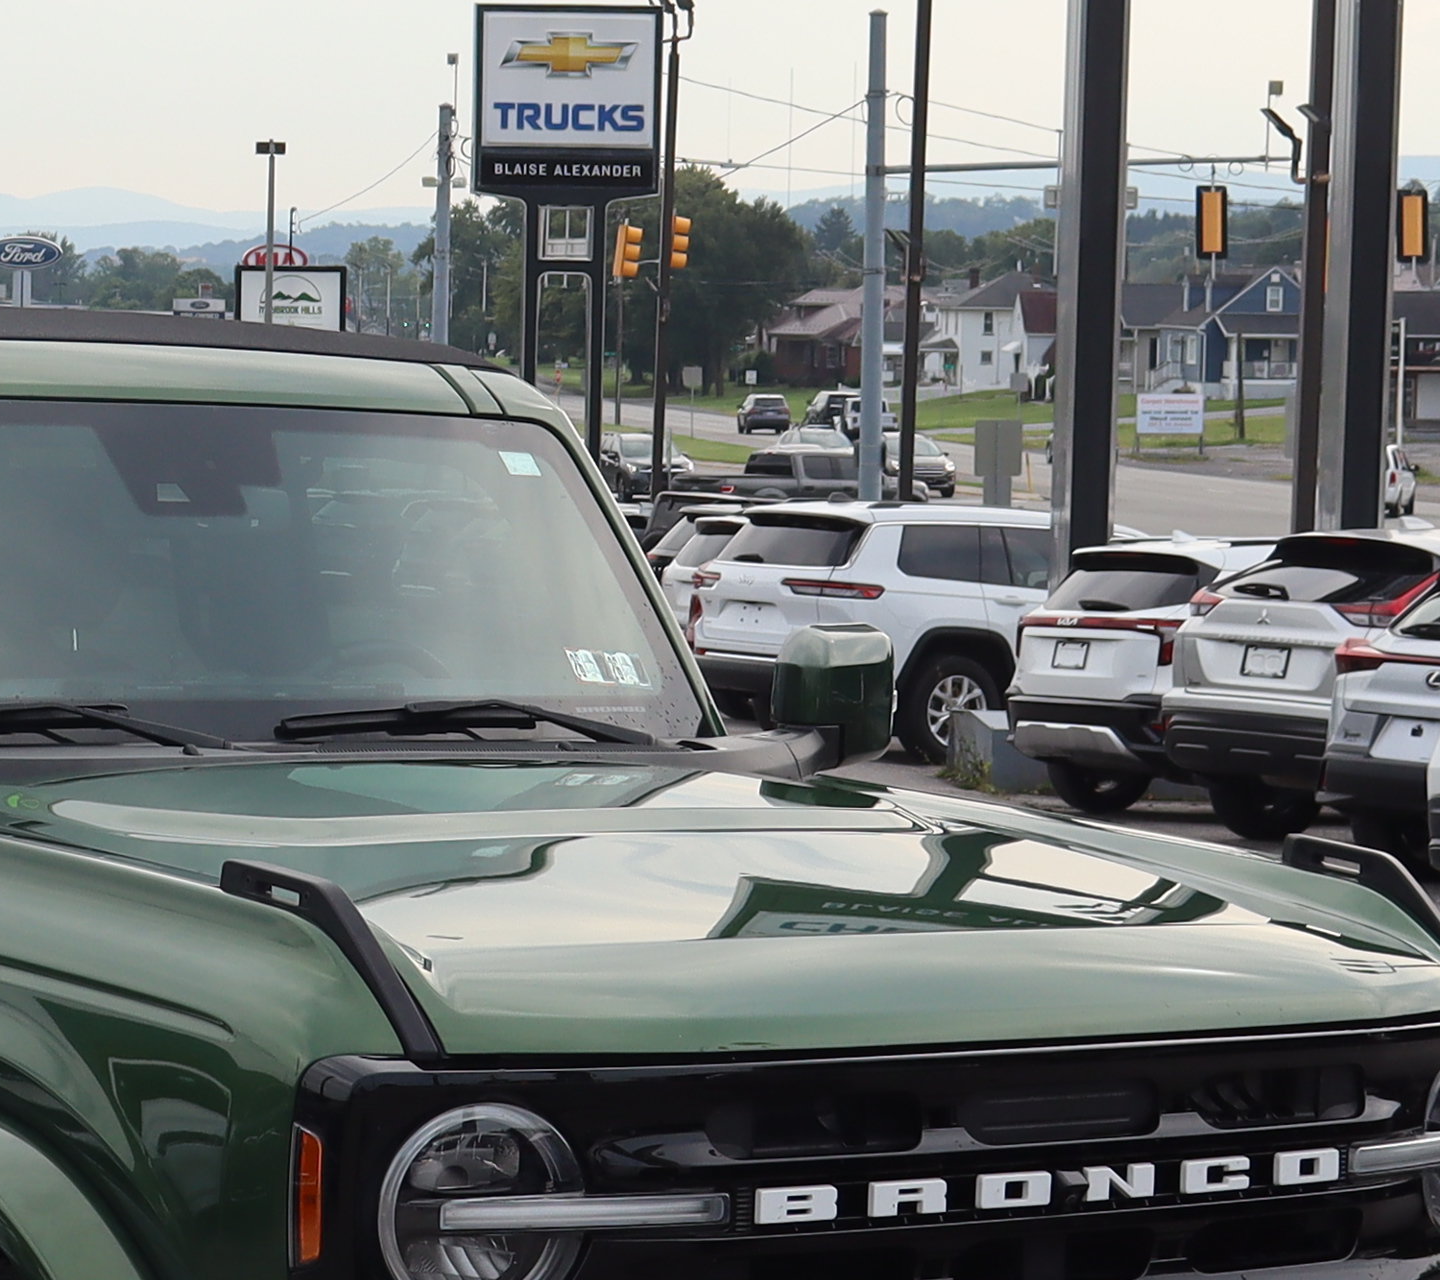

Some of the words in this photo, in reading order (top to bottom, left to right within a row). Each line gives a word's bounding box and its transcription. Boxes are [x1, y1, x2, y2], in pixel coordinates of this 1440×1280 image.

[493, 102, 645, 132] TRUCKS
[494, 162, 547, 176] BLAISE
[553, 164, 642, 177] ALEXANDER
[0, 243, 47, 263] Ford
[300, 306, 323, 315] HILLS
[754, 1147, 1340, 1226] BRONCO
